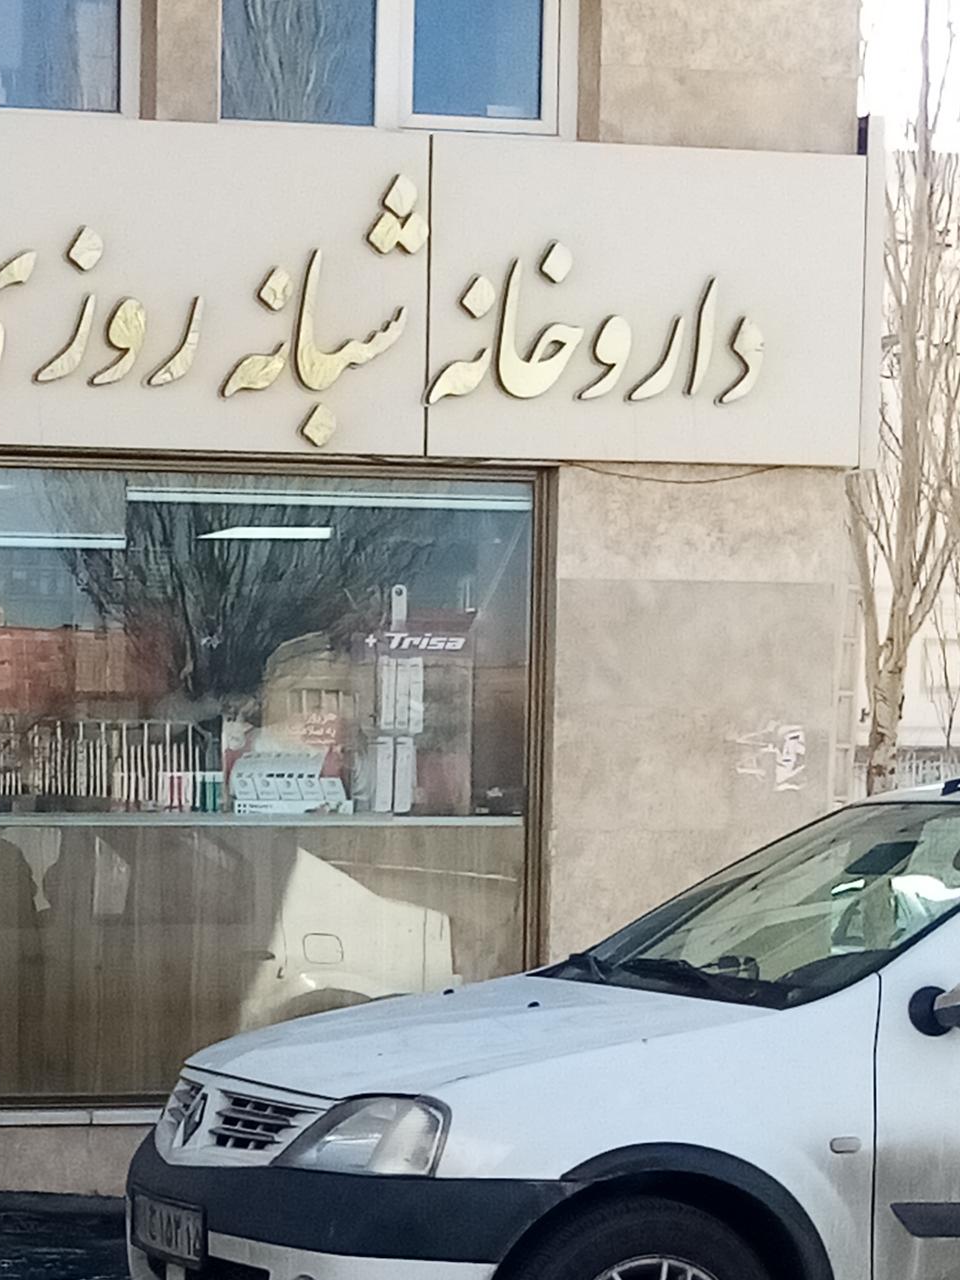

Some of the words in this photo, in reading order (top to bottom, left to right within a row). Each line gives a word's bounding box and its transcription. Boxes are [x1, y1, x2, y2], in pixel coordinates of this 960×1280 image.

[220, 173, 431, 448] شبانه
[424, 239, 767, 406] داروخانه
[384, 632, 467, 651] Trisa
